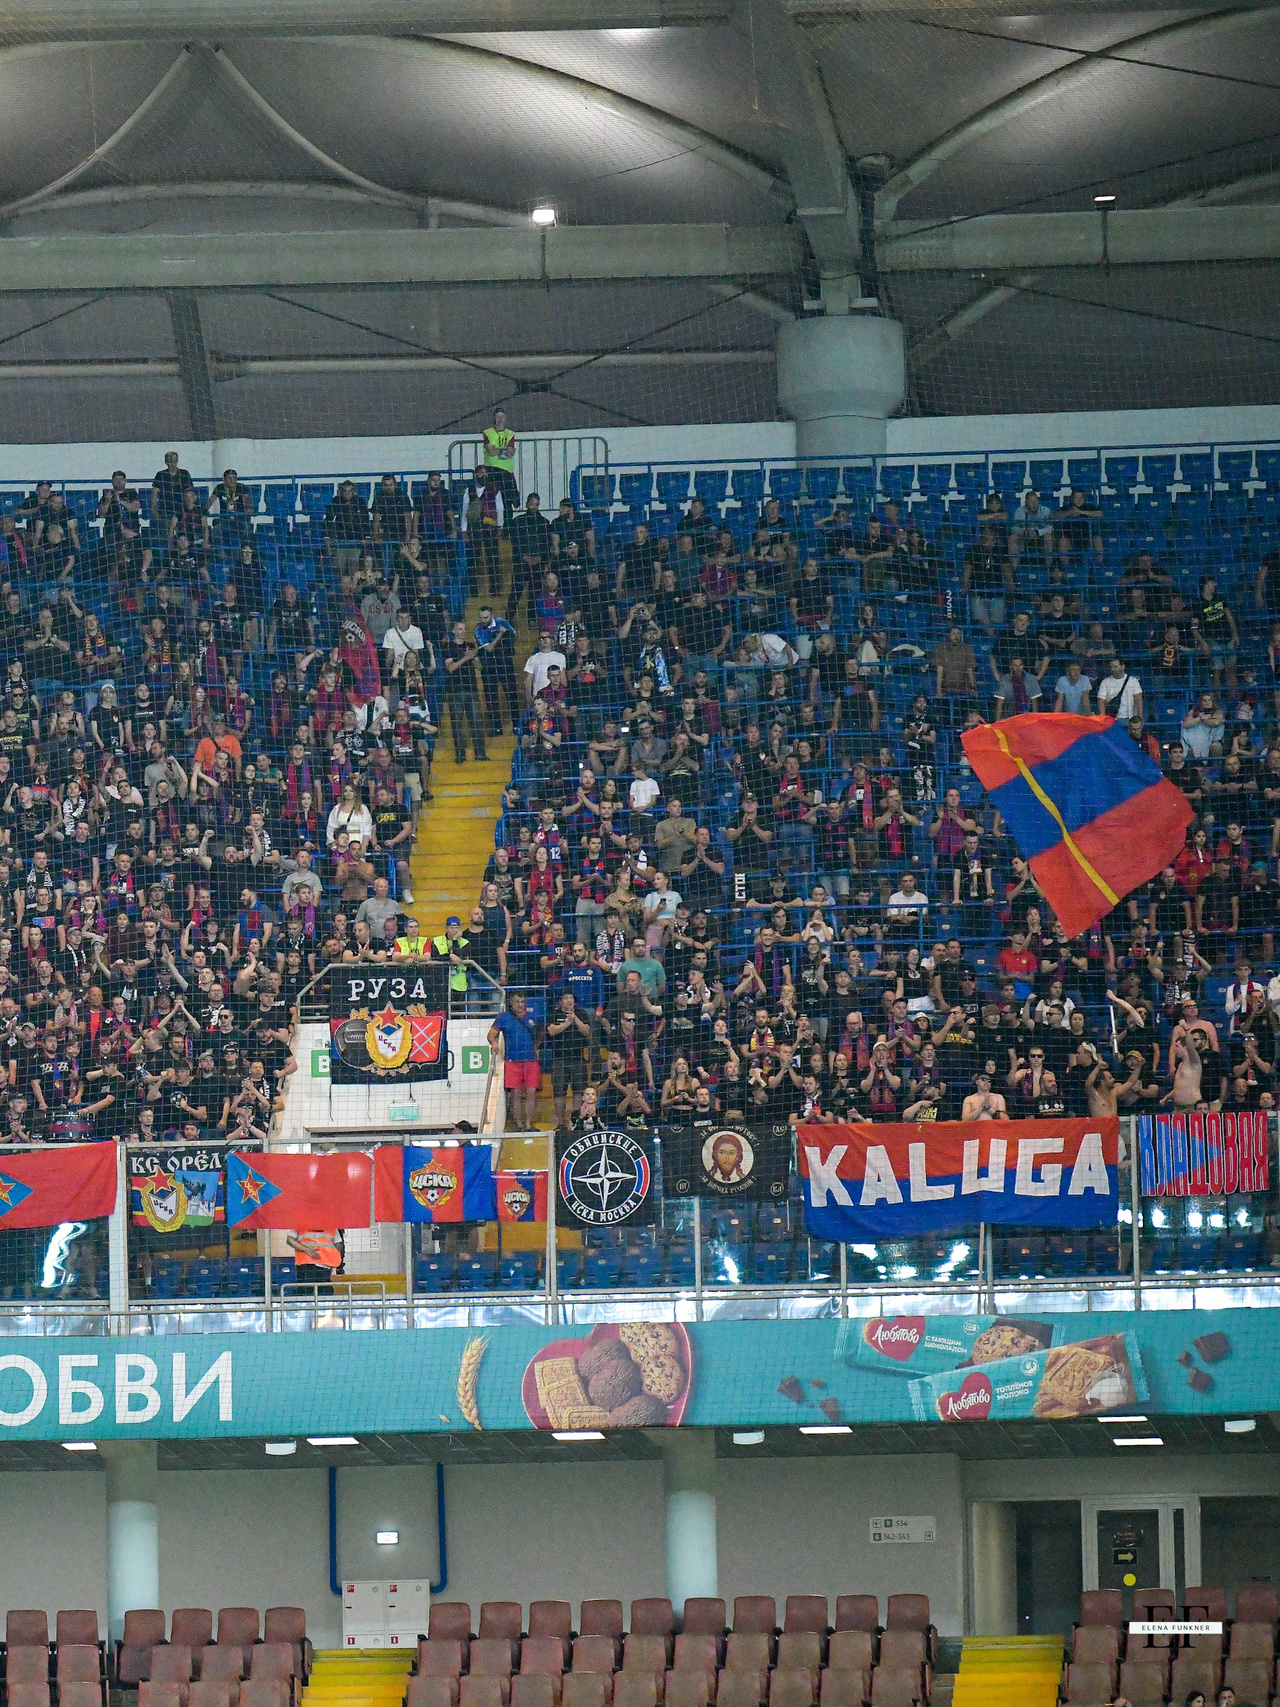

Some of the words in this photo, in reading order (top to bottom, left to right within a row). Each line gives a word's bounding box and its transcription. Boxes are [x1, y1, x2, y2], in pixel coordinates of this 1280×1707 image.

[550, 847, 561, 860] 12
[347, 977, 428, 1001] РУЗА
[378, 1034, 397, 1052] ЦСКА
[570, 1133, 638, 1157] ОБНИНСКИЕ
[1137, 1111, 1269, 1197] КЛАДОВАЯ
[167, 1150, 223, 1173] ОРЁЛ
[804, 1132, 1111, 1209] KALUGA
[412, 1173, 454, 1190] ЦСКА
[153, 1200, 174, 1216] ЦСКА
[505, 1192, 528, 1204] ЦСКА
[571, 1201, 595, 1220] ЦСКА
[600, 1199, 637, 1222] МОСКВА
[872, 1324, 920, 1350] Любятово
[931, 1336, 962, 1347] ТАЮЩИМ
[924, 1341, 968, 1354] ШОКОЛАДОМ
[947, 1388, 991, 1420] Любятово
[997, 1389, 1030, 1401] МОЛОКО
